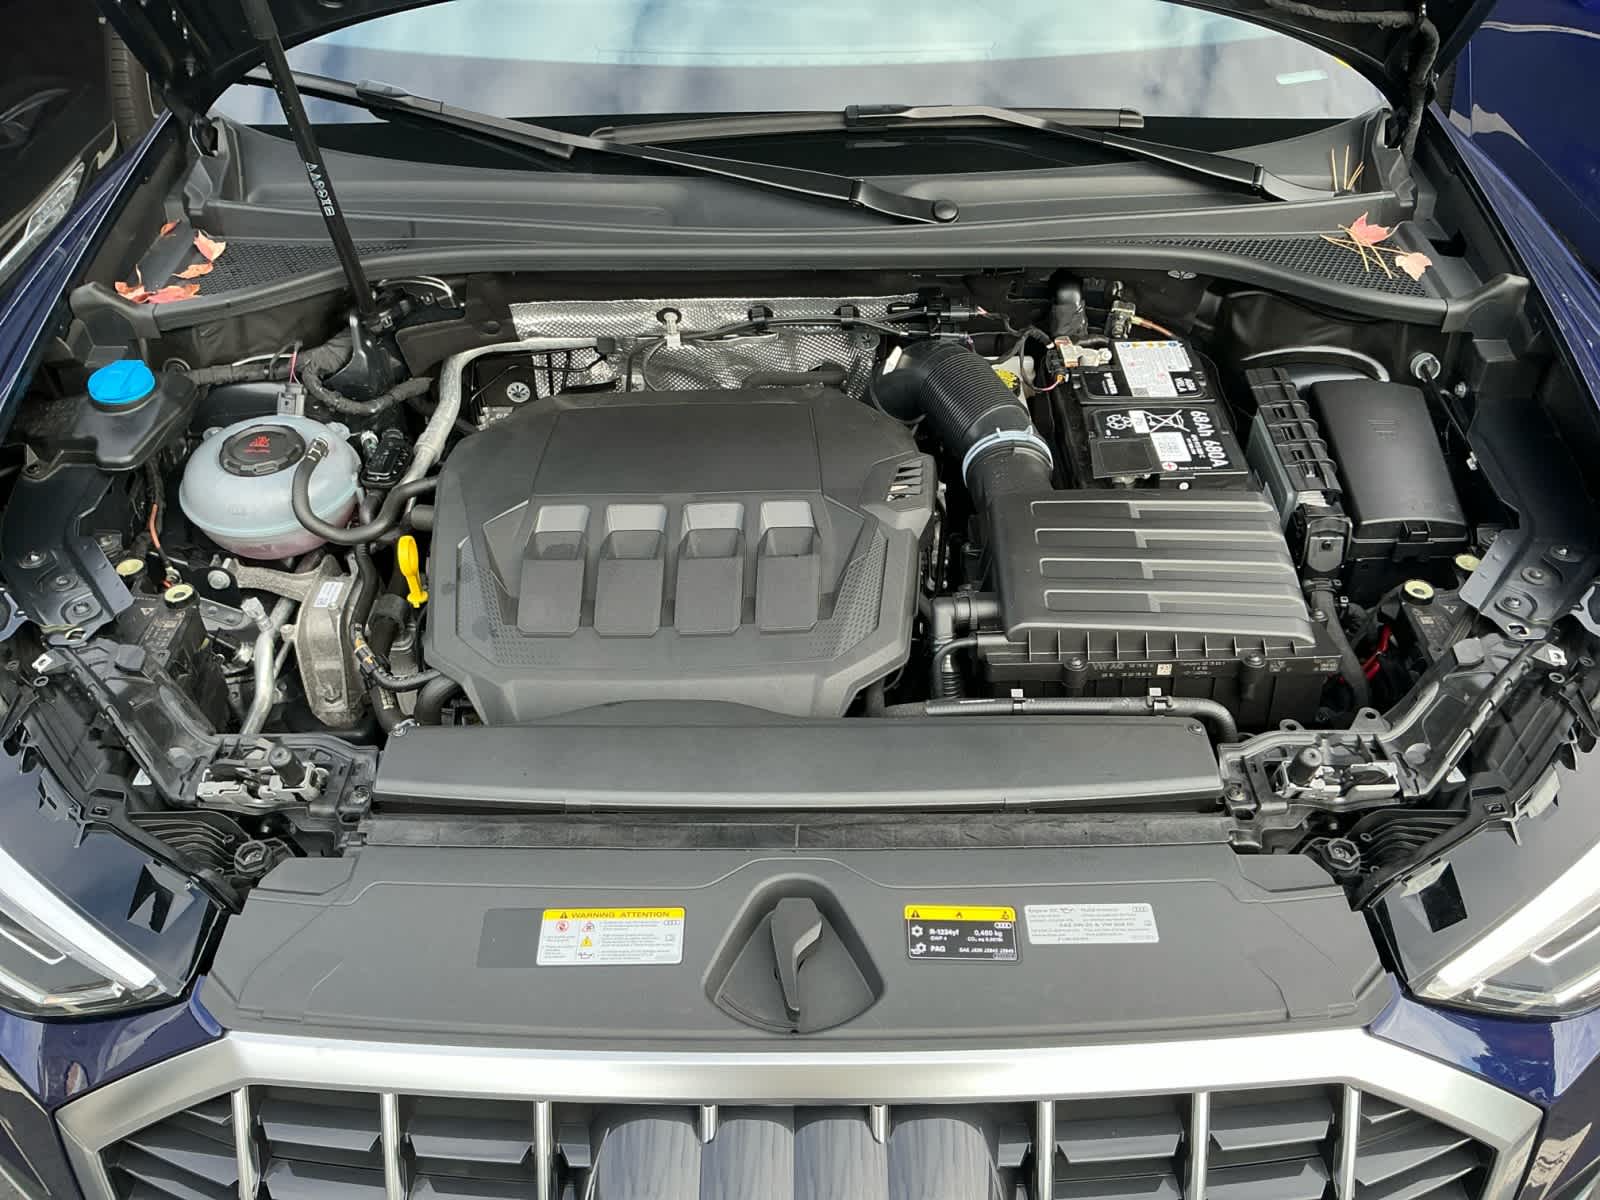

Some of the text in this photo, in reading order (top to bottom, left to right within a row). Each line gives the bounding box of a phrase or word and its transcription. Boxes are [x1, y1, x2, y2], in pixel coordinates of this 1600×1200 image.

[1190, 410, 1215, 437] 68Ah
[1202, 440, 1229, 468] 680A
[929, 928, 960, 937] R-1234yf
[994, 929, 1004, 938] kg
